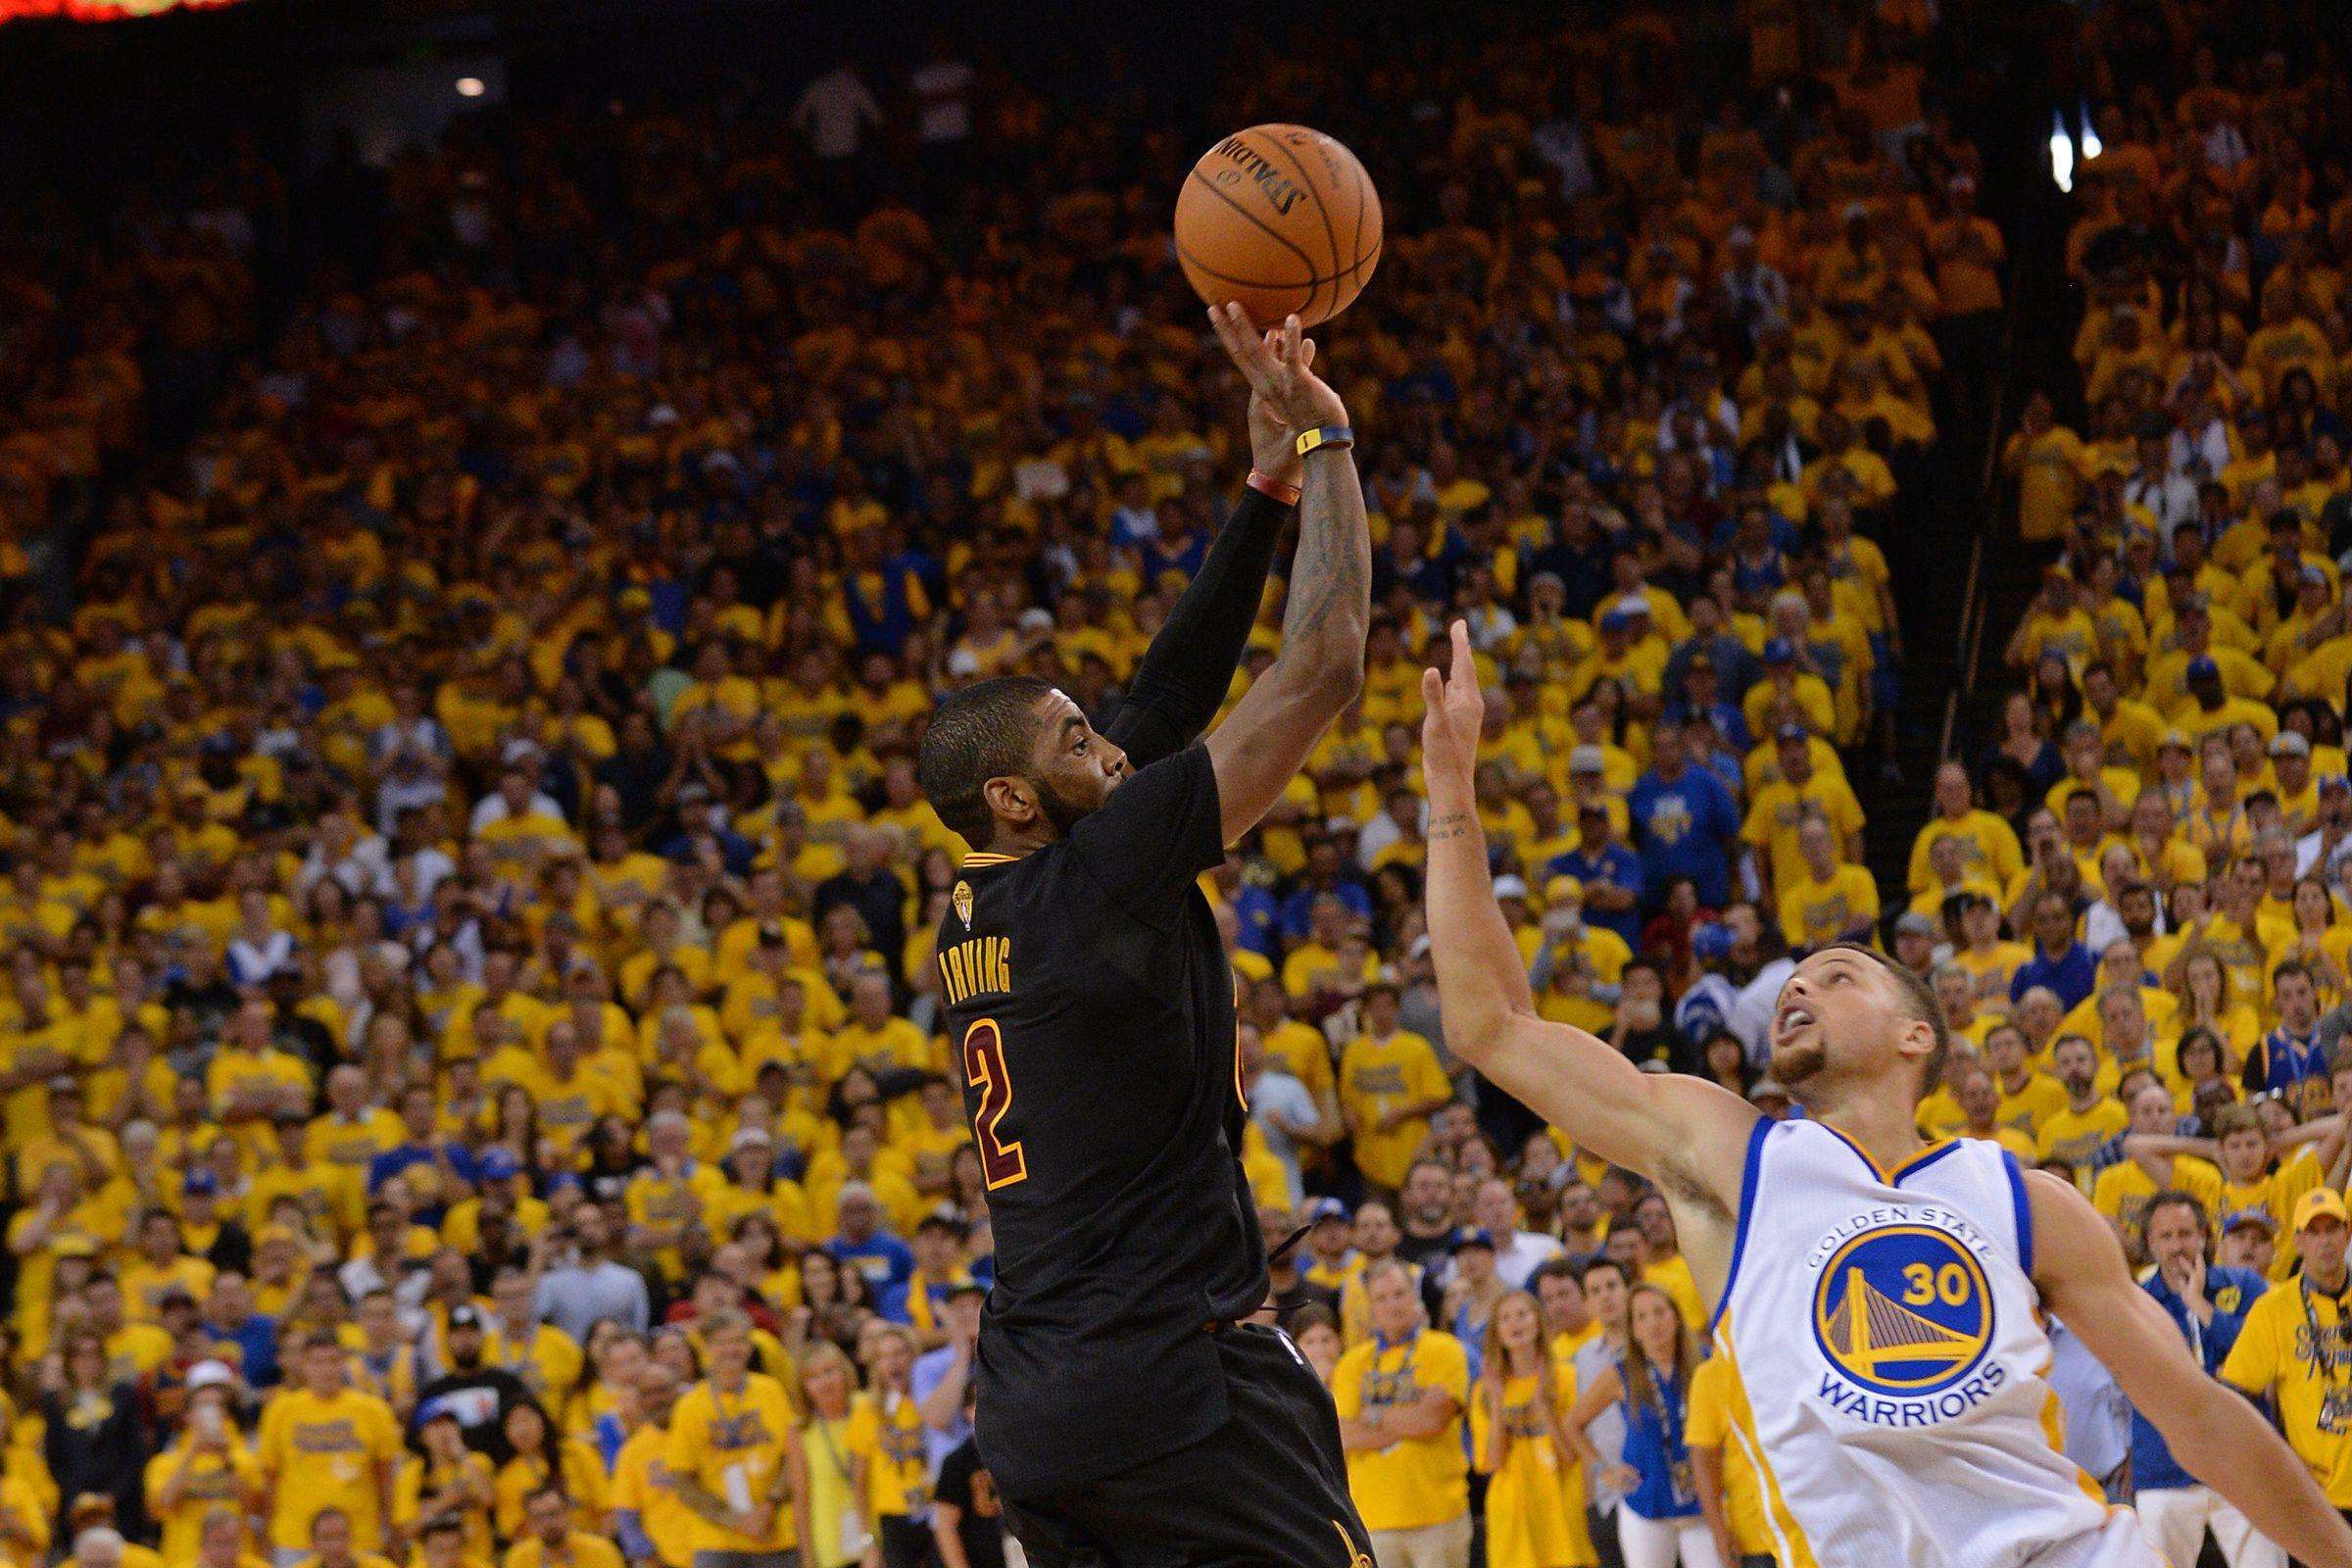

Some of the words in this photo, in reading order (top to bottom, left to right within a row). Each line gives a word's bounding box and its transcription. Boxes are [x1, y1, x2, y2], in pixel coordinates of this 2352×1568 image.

[1216, 138, 1307, 215] SPALDIN
[939, 936, 1010, 1004] IRVING
[964, 1018, 1027, 1191] 2
[1809, 1207, 1908, 1268] GOLDEN
[1922, 1208, 1992, 1261] STATE
[1901, 1261, 1971, 1306] 30
[1819, 1361, 2005, 1426] WARRIORS
